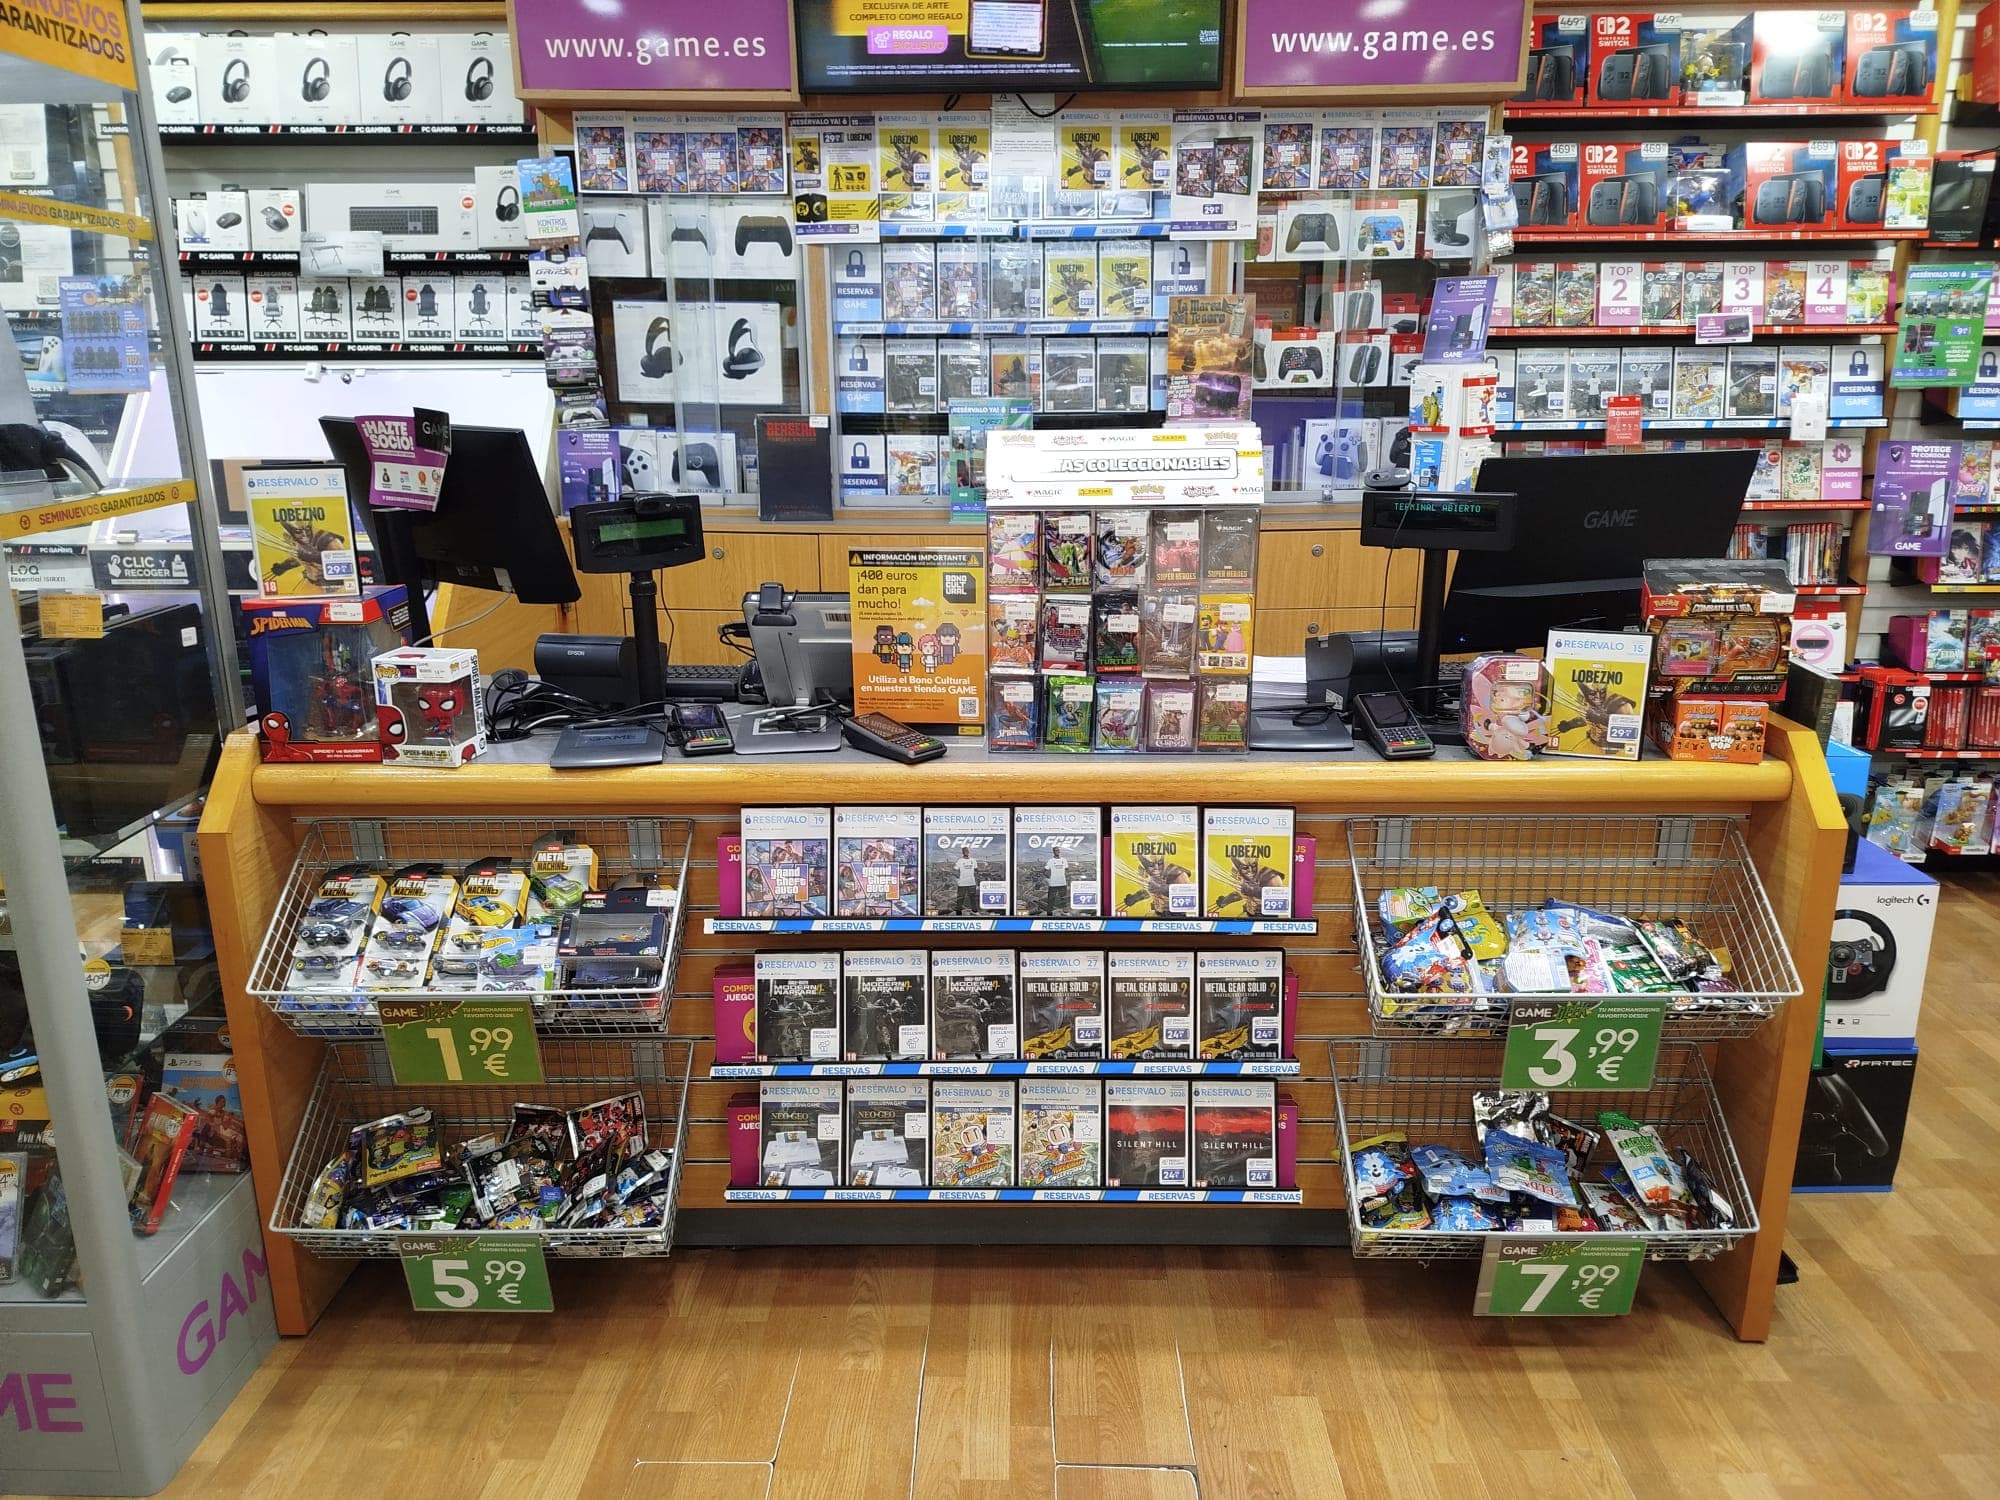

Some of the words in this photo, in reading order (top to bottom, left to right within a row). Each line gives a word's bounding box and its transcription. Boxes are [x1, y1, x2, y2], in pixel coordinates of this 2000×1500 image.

[862, 1, 910, 11] EXCLUSIVA
[912, 1, 925, 11] DE
[926, 1, 951, 11] ARTE
[848, 13, 897, 22] COMPLETO
[898, 13, 926, 22] COMO
[926, 12, 964, 22] REGALO
[891, 30, 934, 40] REGALO
[1854, 35, 1887, 43] SWITCH
[1271, 29, 1496, 60] www.game.es
[544, 36, 767, 66] www.game.es
[1214, 113, 1228, 122] YA!
[355, 126, 364, 134] PC
[365, 126, 391, 134] GAMING
[1071, 132, 1101, 142] LOBEZNO
[1586, 167, 1617, 175] SWITCH
[199, 252, 208, 261] PC
[208, 252, 234, 261] GAMING
[1608, 265, 1634, 277] TOP
[1731, 265, 1756, 276] TOP
[1816, 264, 1840, 275] TOP
[1612, 278, 1628, 301] 2
[1733, 278, 1749, 301] 3
[1816, 278, 1834, 300] 4
[1442, 350, 1464, 359] GAME
[1614, 408, 1641, 418] ONLINE
[362, 420, 409, 438] ¡HAZTE
[370, 434, 415, 451] SOCIO!
[1910, 445, 1952, 454] PROTEGE
[1921, 452, 1951, 460] CONSOLA
[1085, 455, 1232, 472] COLECCIONABLES
[256, 476, 319, 488] RESÉRVALO
[327, 477, 339, 488] 15
[38, 504, 100, 526] SEMINUEVOS
[100, 491, 166, 513] GARANTIZADOS
[272, 505, 326, 523] LOBEZNO
[1442, 503, 1482, 514] ABIERTO
[1894, 541, 1922, 551] GAME
[122, 555, 155, 569] CLIC
[863, 552, 917, 562] INFORMACIÓN
[918, 554, 968, 562] IMPORTANTE
[10, 564, 40, 576] LOQ
[123, 567, 171, 578] RECOGER
[10, 576, 43, 584] Essential
[857, 569, 884, 583] ¡400
[886, 571, 919, 581] euros
[945, 574, 968, 583] BONO
[263, 580, 277, 593] 18
[857, 583, 880, 595] dan
[881, 585, 908, 597] para
[945, 588, 968, 596] URAL
[857, 597, 902, 609] mucho!
[1692, 603, 1727, 614] COMBATE
[1726, 603, 1736, 613] DE
[1735, 603, 1754, 613] LIGA
[250, 615, 314, 637] SPIDER-MAN
[1563, 638, 1625, 652] RESÉRVALO
[1632, 643, 1645, 653] 15
[567, 649, 586, 657] EPSON
[375, 664, 400, 679] POP!
[861, 685, 873, 693] en
[875, 685, 913, 693] nuestras
[914, 684, 947, 694] tiendas
[947, 686, 978, 694] GAME
[1708, 735, 1734, 745] PUCHI
[1709, 742, 1732, 751] POP
[814, 816, 825, 825] 19
[932, 814, 986, 824] RESÉRVALO
[992, 816, 1004, 825] 25
[1131, 841, 1177, 856] LOBEZNO
[1225, 844, 1271, 859] LOBEZNO
[770, 866, 800, 880] grand
[861, 865, 892, 878] grand
[776, 875, 807, 886] theft
[774, 883, 799, 895] auto
[1876, 894, 1915, 907] logitech
[712, 921, 763, 931] RESERVAS
[1263, 922, 1314, 932] RESERVAS
[764, 958, 817, 969] RESÉRVALO
[822, 961, 836, 970] 23
[1028, 957, 1081, 967] RESÉRVALO
[1087, 959, 1098, 968] 27
[1117, 958, 1170, 968] RESÉRVALO
[1176, 960, 1188, 969] 27
[1027, 981, 1049, 994] METAL
[1050, 981, 1069, 994] GEAR
[1070, 981, 1090, 994] SOLID
[381, 1007, 419, 1019] GAME
[1515, 1007, 1553, 1018] GAME
[174, 1022, 197, 1031] PS4
[179, 1058, 203, 1067] PS5
[714, 1066, 764, 1076] RESERVAS
[1251, 1064, 1300, 1074] RESERVAS
[827, 1088, 837, 1097] 12
[913, 1086, 923, 1095] 12
[941, 1086, 993, 1098] RESÉRVALO
[998, 1088, 1010, 1098] 28
[1028, 1085, 1080, 1096] RESÉRVALO
[1085, 1087, 1097, 1096] 28
[1114, 1085, 1167, 1097] RESÉRVALO
[1116, 1140, 1154, 1149] SILENT
[1155, 1140, 1178, 1149] HILL
[1203, 1141, 1239, 1150] SILENT
[1241, 1141, 1265, 1150] HILL
[729, 1190, 777, 1200] RESERVAS
[1253, 1191, 1302, 1202] RESERVAS
